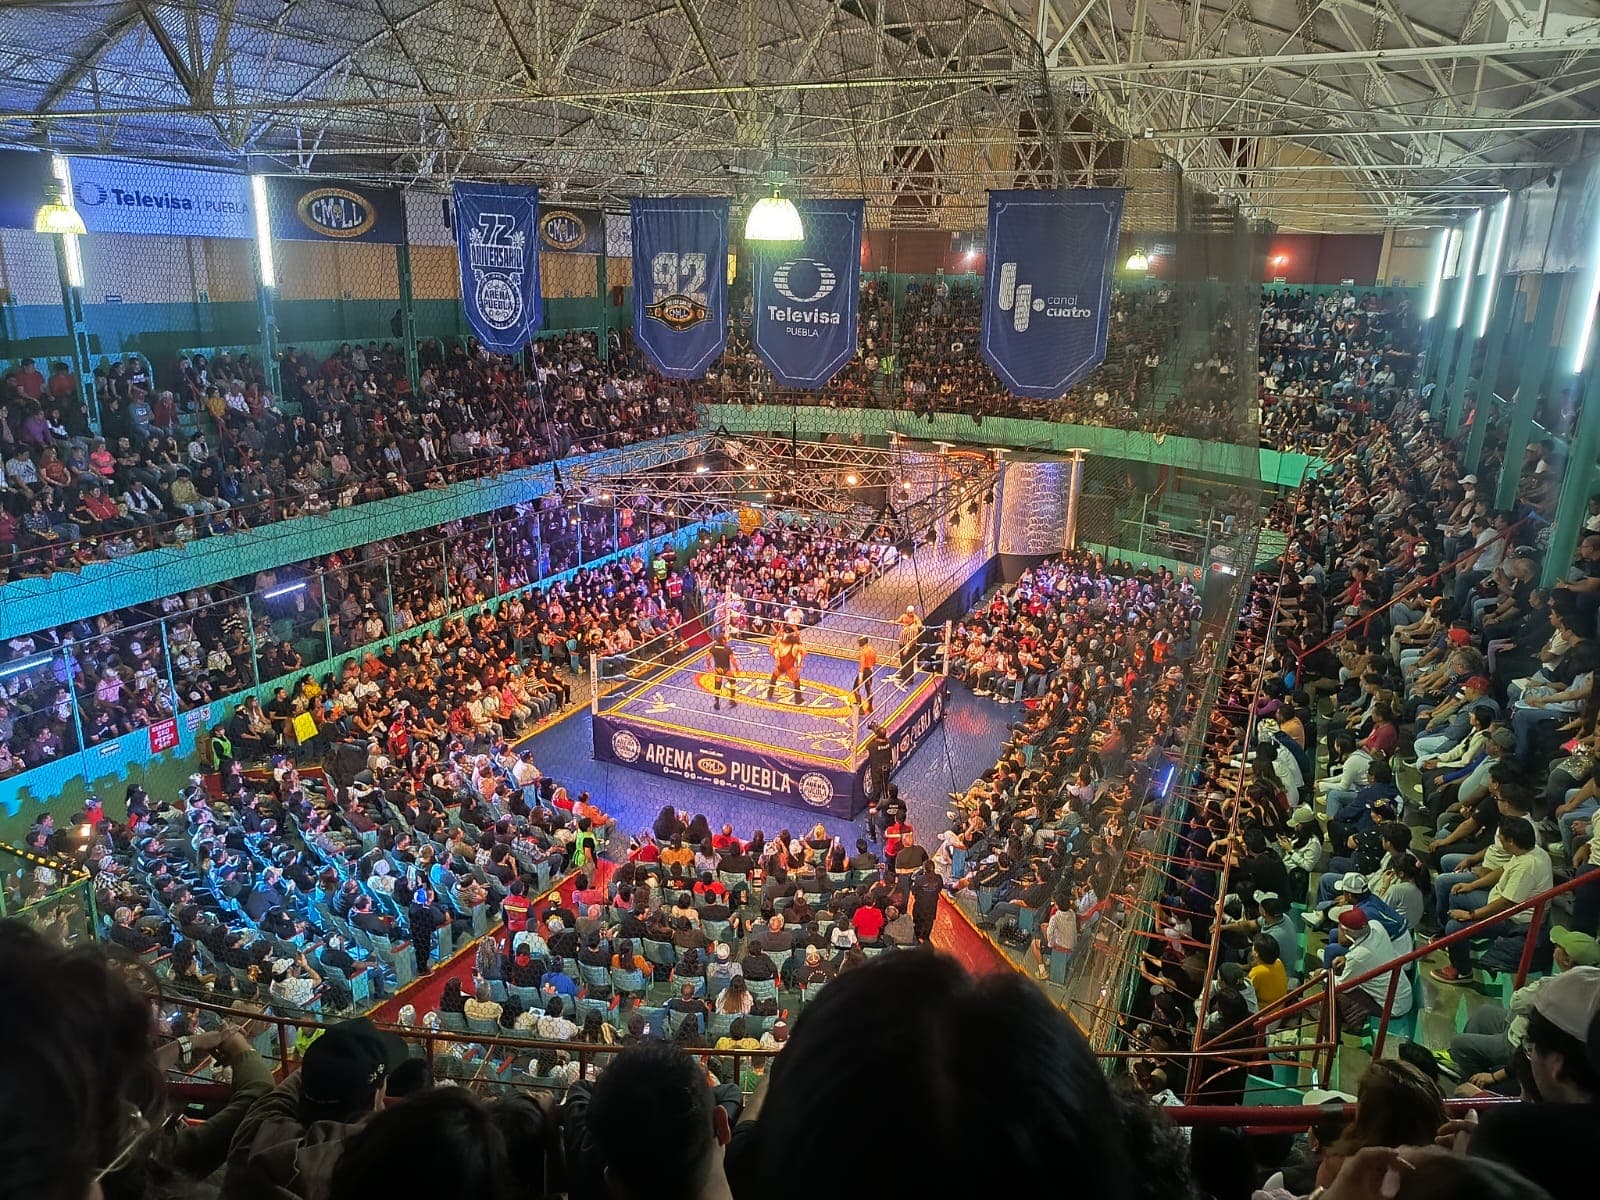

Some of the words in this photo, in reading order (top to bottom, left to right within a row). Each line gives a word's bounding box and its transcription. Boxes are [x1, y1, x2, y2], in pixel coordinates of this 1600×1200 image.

[111, 188, 193, 211] Televisa
[205, 199, 249, 214] PUEBLA
[311, 198, 363, 229] CMLL
[478, 212, 516, 247] 72
[470, 244, 524, 269] ANIVERSARIO
[651, 252, 708, 306] 92
[483, 300, 513, 311] PUEBLA
[484, 290, 510, 301] ARENA
[1046, 295, 1079, 306] canal
[767, 305, 841, 325] Televisa
[1046, 307, 1091, 318] cuatro
[786, 327, 819, 337] PUEBLA
[645, 743, 695, 772] ARENA
[730, 761, 792, 795] PUEBLA
